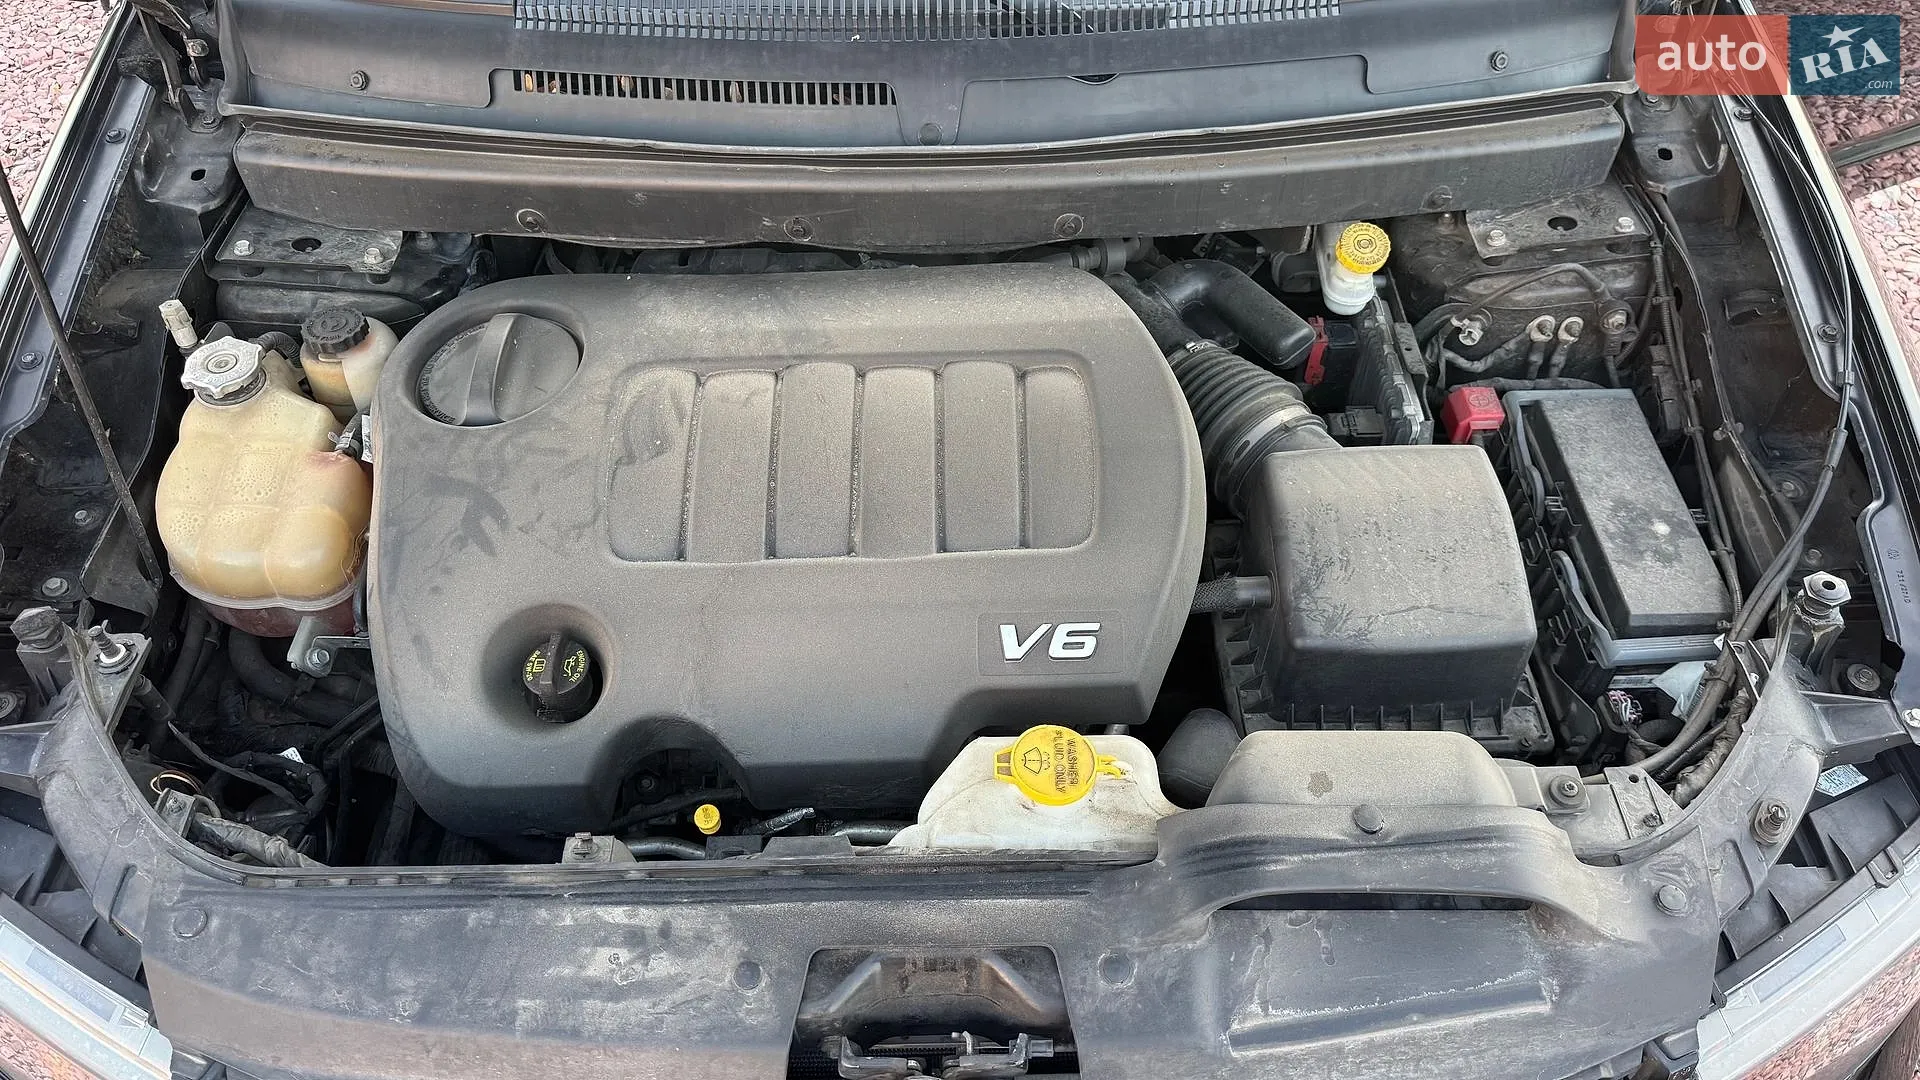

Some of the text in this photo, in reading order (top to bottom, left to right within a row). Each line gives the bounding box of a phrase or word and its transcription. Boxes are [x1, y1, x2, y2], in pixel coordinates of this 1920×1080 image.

[529, 650, 541, 662] SAE
[998, 622, 1101, 662] V6
[569, 650, 585, 682] ENGINE OIL
[1053, 729, 1067, 794] FLUID ONLY
[1066, 737, 1079, 787] WASHER
